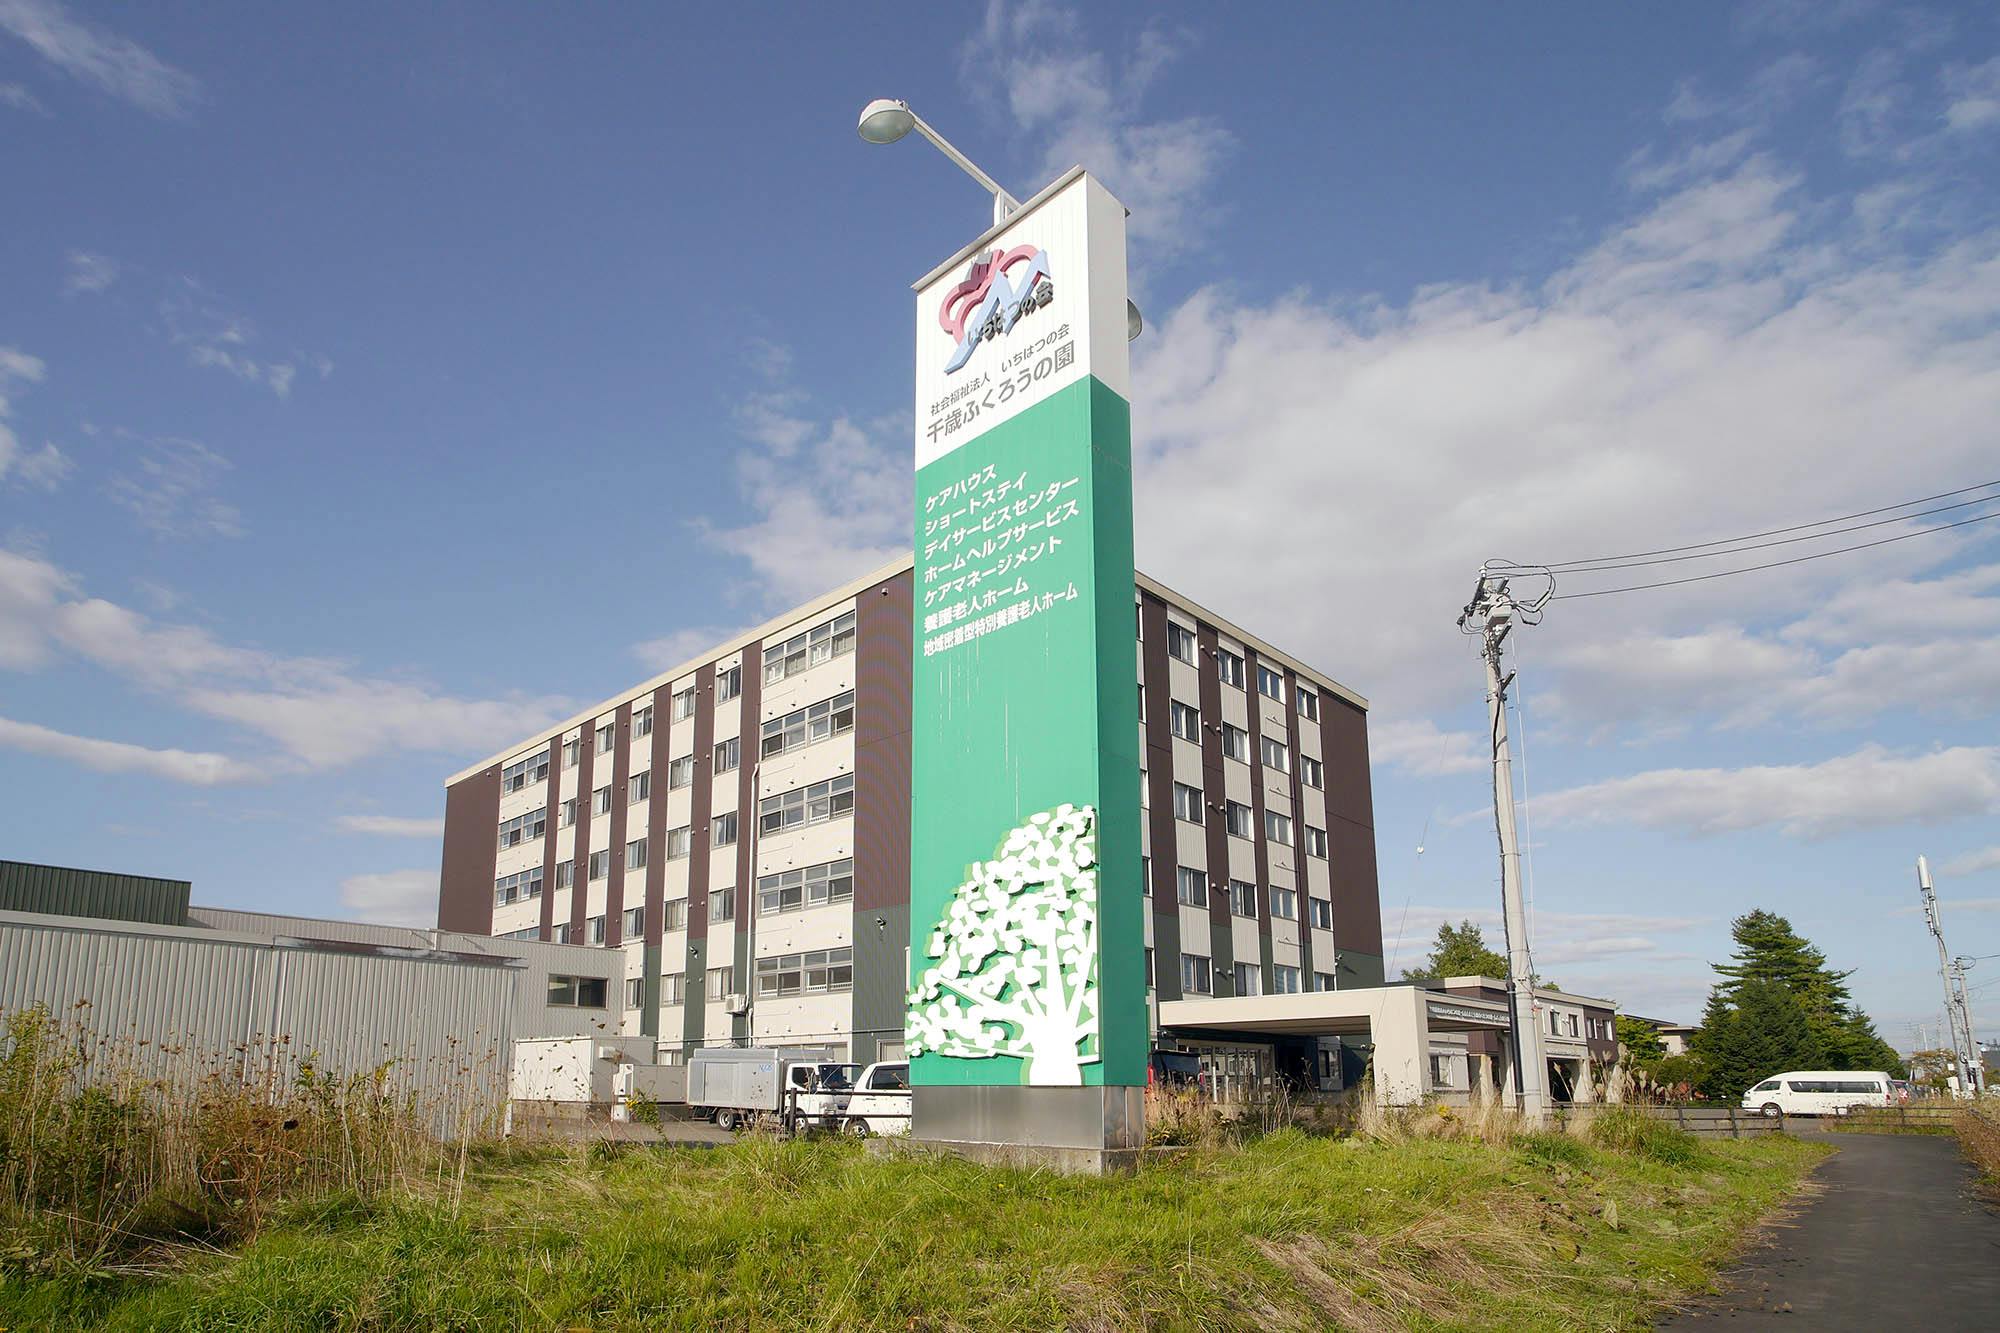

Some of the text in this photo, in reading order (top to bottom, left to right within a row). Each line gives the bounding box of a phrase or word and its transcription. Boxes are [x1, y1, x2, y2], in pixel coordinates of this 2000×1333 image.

[926, 340, 1075, 443] 千歳ふくろうの園
[930, 323, 1070, 416] 社会福祉法人 いちはつの会
[924, 477, 1080, 560] デイサービスセンター
[925, 463, 998, 513] ケアハウス
[925, 471, 1027, 537] ショートステイ
[924, 499, 1080, 584] ホームヘルプサービス
[924, 535, 1063, 608] ケアマネージメント
[923, 577, 1029, 634] 養護老人ホーム
[923, 582, 1079, 657] 地域密着型特別養護老人ホーム
